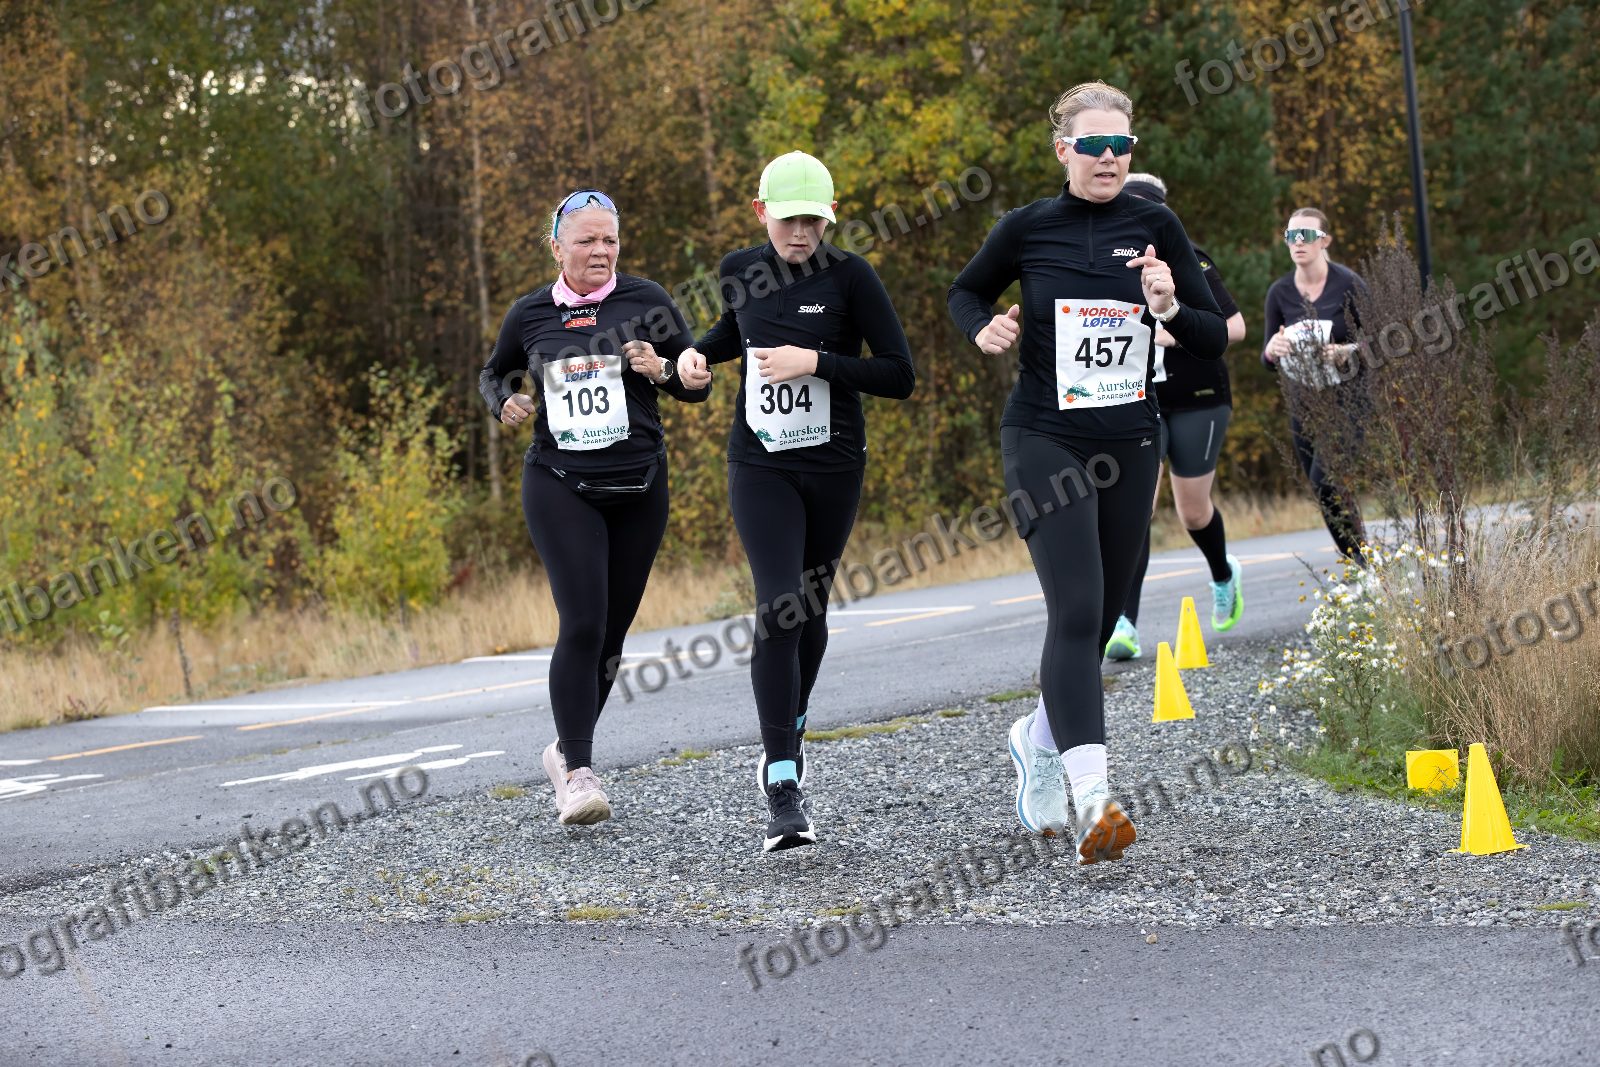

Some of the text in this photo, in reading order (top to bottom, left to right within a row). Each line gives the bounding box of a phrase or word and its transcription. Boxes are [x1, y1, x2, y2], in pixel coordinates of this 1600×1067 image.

[1077, 307, 1130, 318] NORGES
[1082, 317, 1126, 328] LØPET
[1075, 336, 1133, 368] 457
[561, 360, 606, 374] NORGES
[565, 370, 600, 383] LØPET
[1097, 379, 1143, 393] Aurskog
[562, 386, 610, 418] 103
[760, 383, 813, 415] 304
[582, 425, 626, 439] Aurskog
[779, 425, 828, 439] Aurskog
